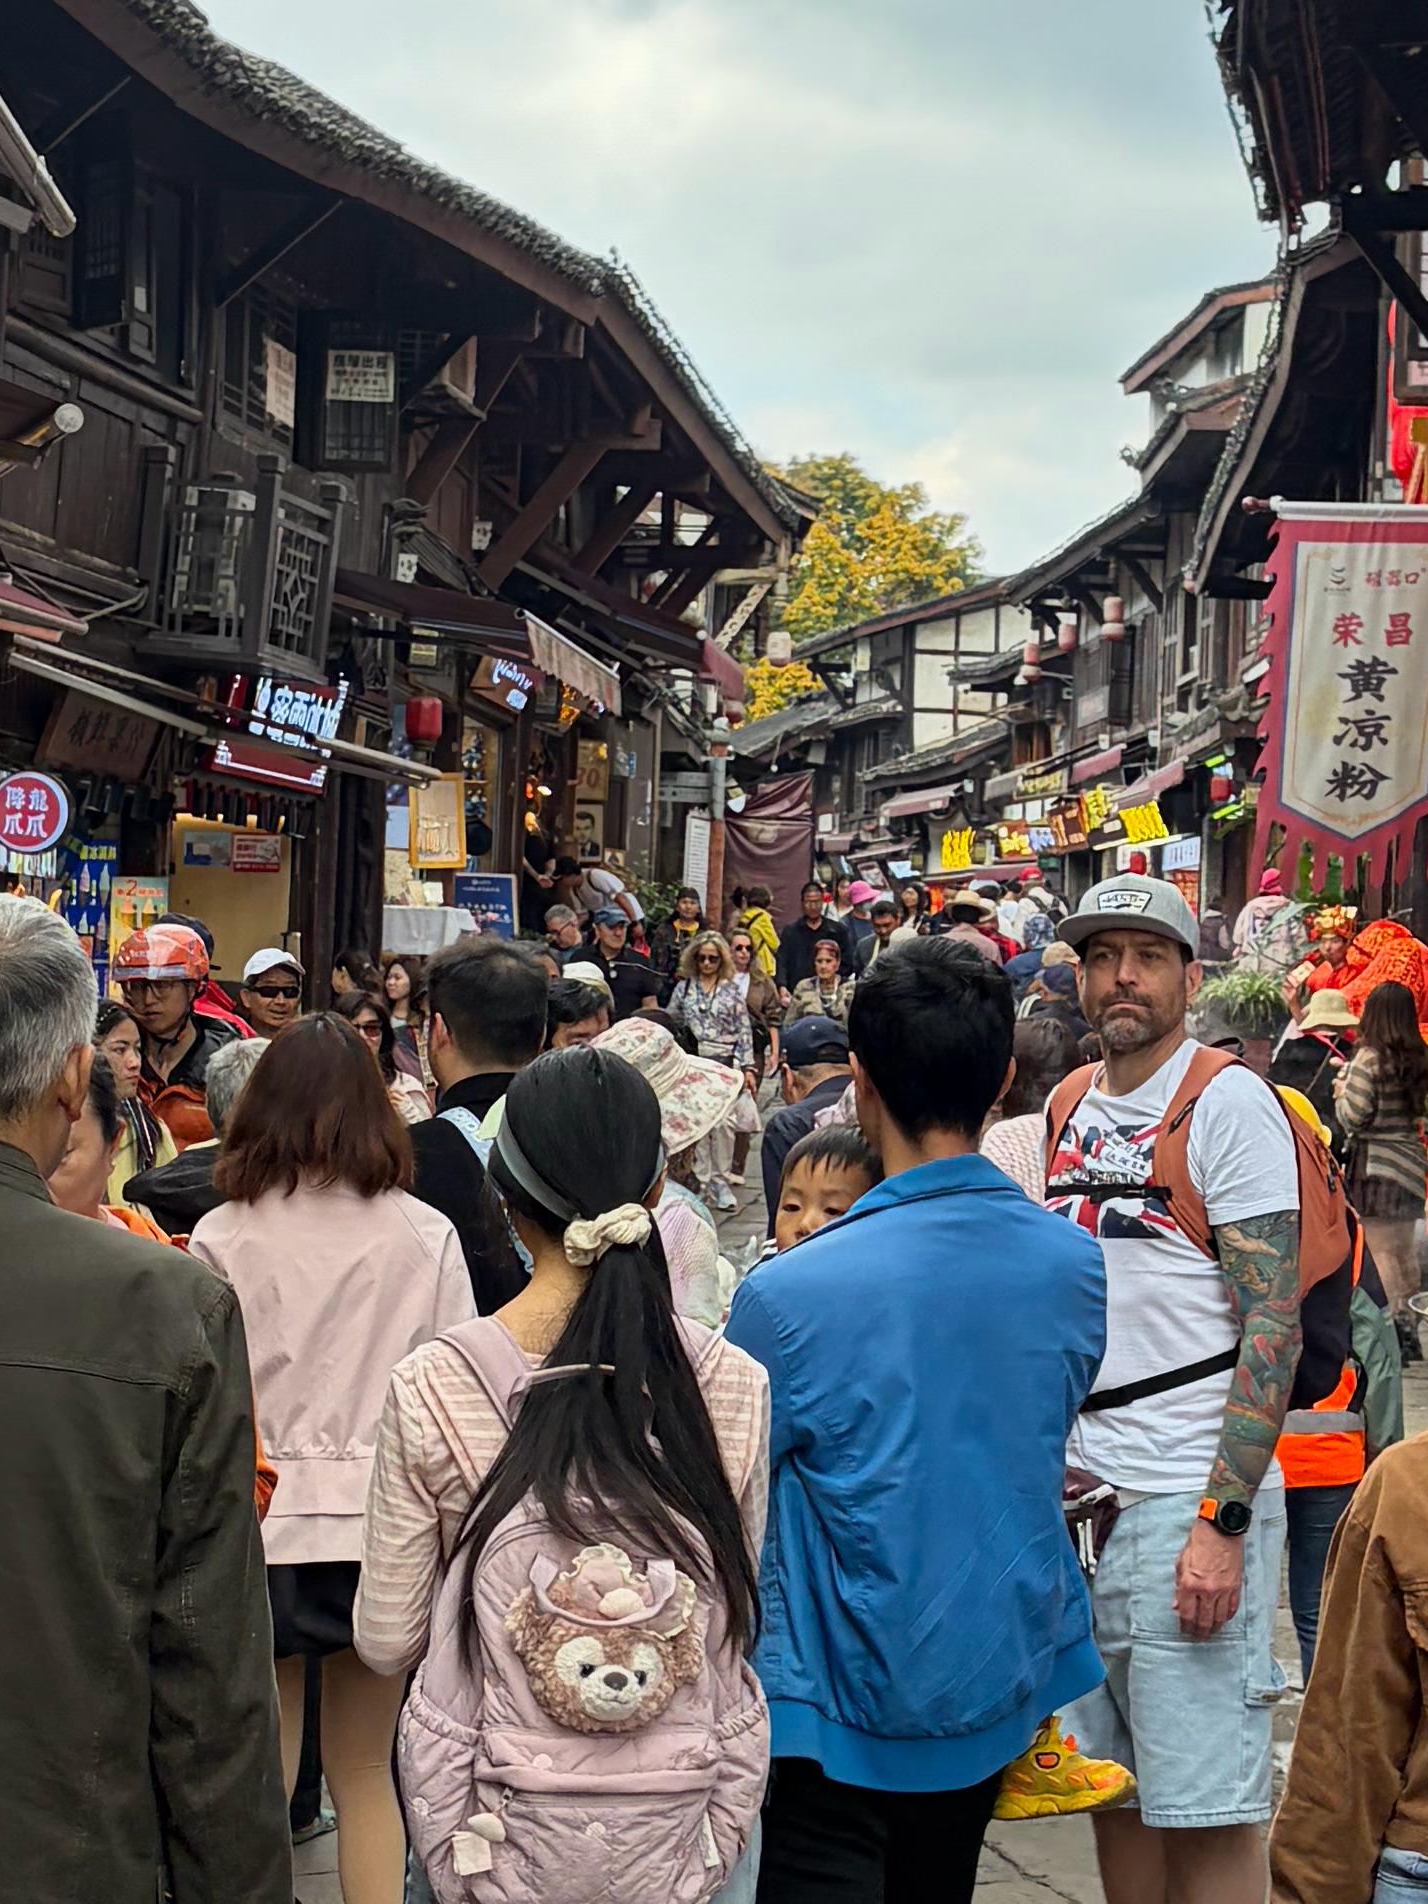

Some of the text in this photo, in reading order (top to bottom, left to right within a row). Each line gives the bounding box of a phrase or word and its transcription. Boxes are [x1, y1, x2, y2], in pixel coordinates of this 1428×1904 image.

[1331, 611, 1414, 648] 荣昌
[1324, 655, 1399, 803] 黄凉粉
